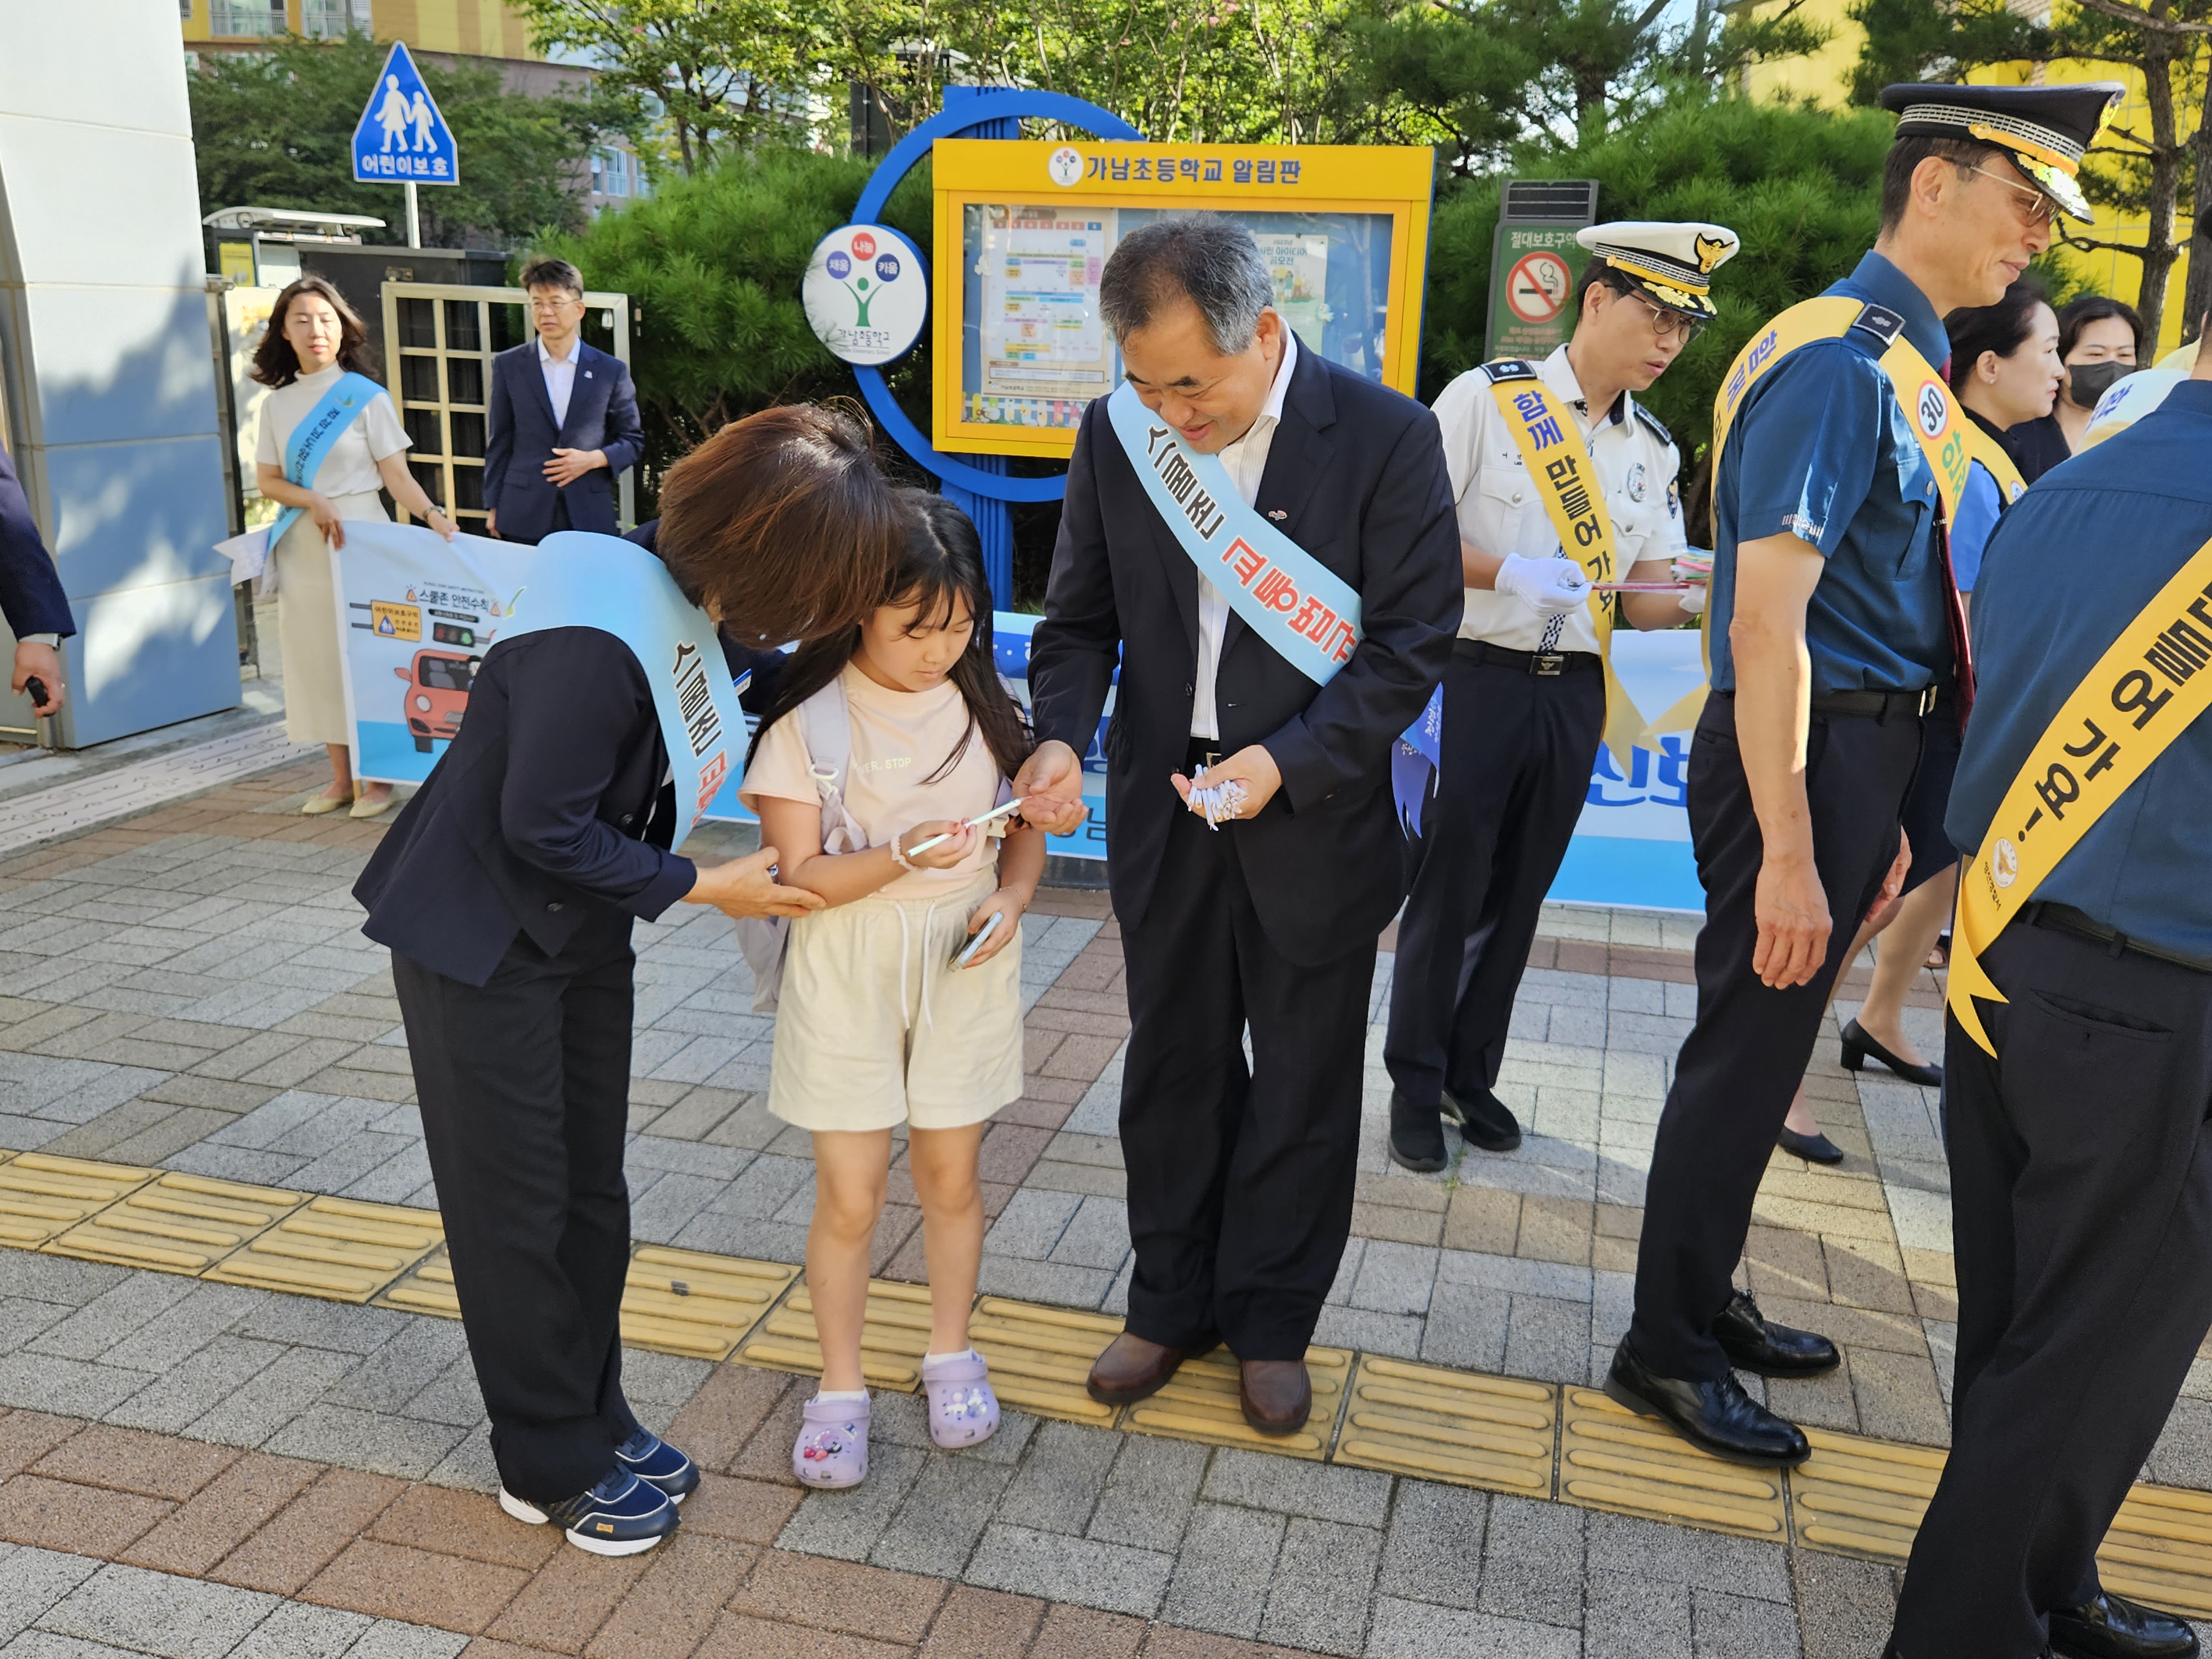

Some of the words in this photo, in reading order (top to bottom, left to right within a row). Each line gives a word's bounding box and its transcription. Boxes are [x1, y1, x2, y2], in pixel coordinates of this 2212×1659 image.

[362, 154, 450, 178] 어린이보호
[1087, 156, 1223, 182] 가남초등학교
[1233, 158, 1302, 184] 알림판
[853, 240, 874, 254] 나눔
[1276, 247, 1308, 257] 아이디어
[1510, 231, 1576, 249] 절대보호구역
[828, 258, 849, 272] 채움
[878, 261, 899, 275] 키움
[837, 328, 890, 347] 가남초등학교
[1921, 387, 1945, 432] 30
[1512, 389, 1564, 452] 함께
[1545, 454, 1603, 547] 만들어
[1147, 425, 1226, 541] 스쿨존
[1221, 536, 1358, 662] 교통법규
[419, 588, 449, 606] 스쿨존
[451, 593, 489, 613] 안전수칙
[672, 641, 722, 758] 스쿨존
[884, 757, 912, 770] STOP
[2017, 717, 2122, 843] 가요!
